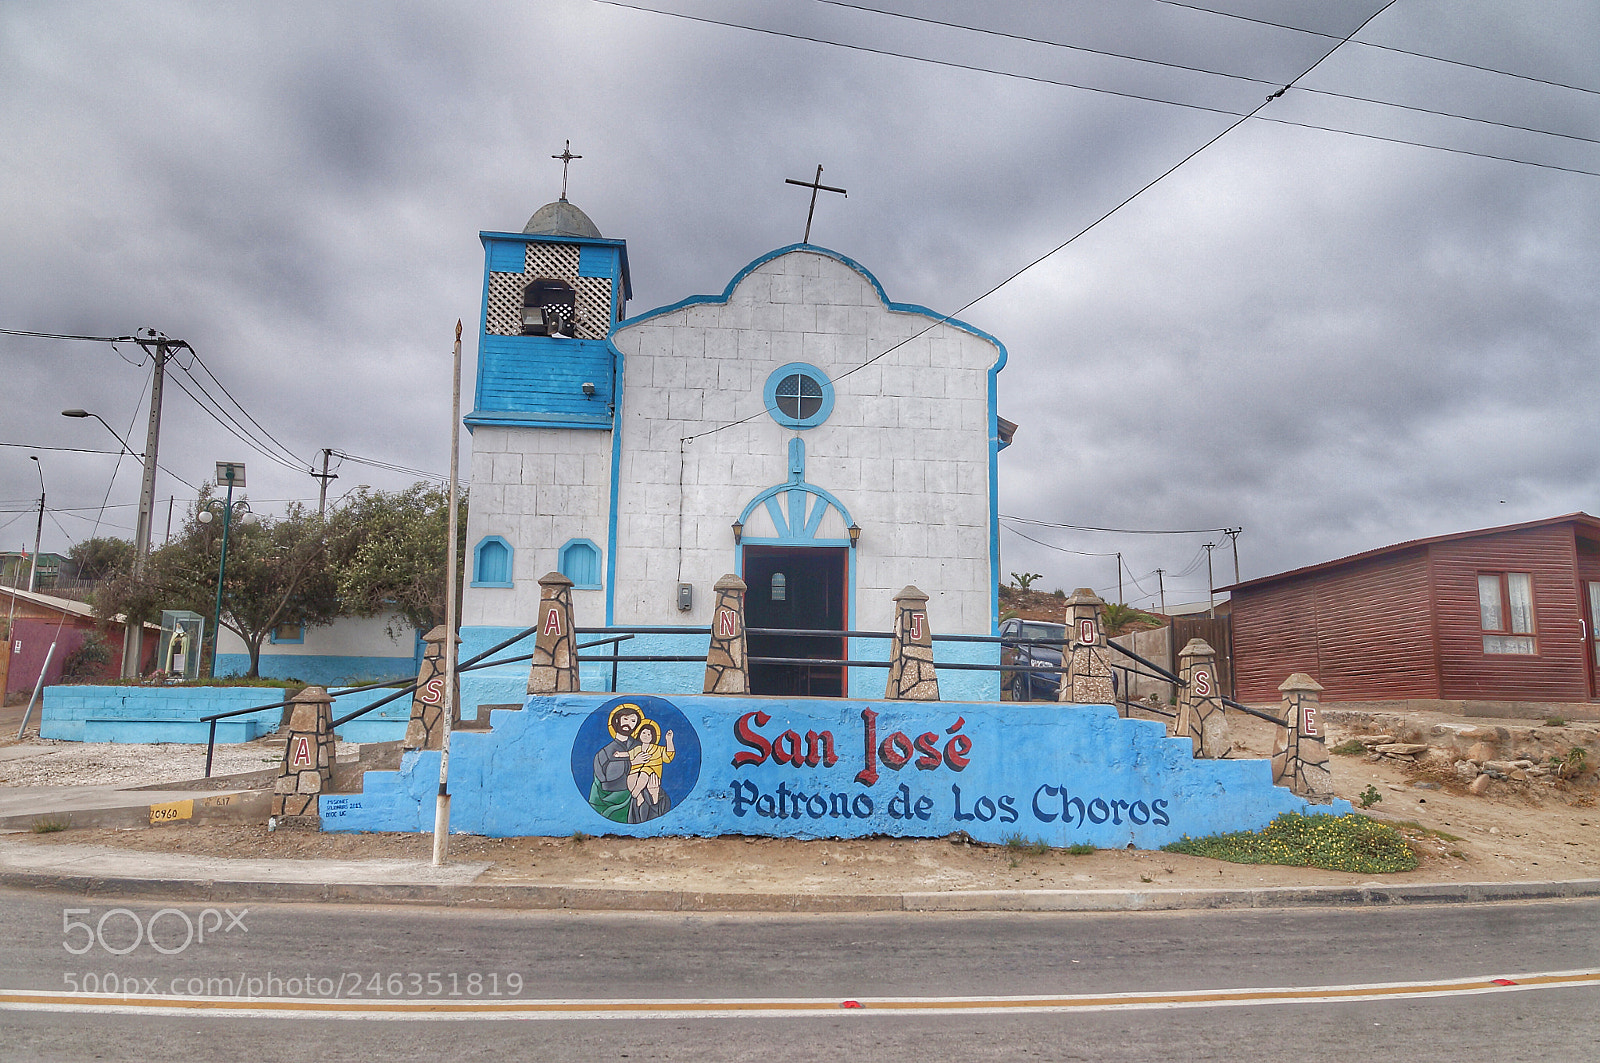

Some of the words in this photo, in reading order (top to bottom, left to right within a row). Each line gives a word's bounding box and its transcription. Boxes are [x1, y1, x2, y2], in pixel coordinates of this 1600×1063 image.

[544, 609, 561, 636] A
[720, 611, 735, 636] N
[910, 614, 925, 640] J
[1080, 619, 1095, 645] O
[422, 679, 444, 703] S
[1195, 671, 1210, 696] S
[1304, 708, 1318, 736] E
[293, 737, 311, 766] A
[731, 710, 839, 769] San
[854, 707, 973, 787] José
[729, 779, 874, 820] Patrono
[888, 783, 933, 822] de
[952, 783, 1019, 824] Los
[1032, 784, 1170, 829] Choros
